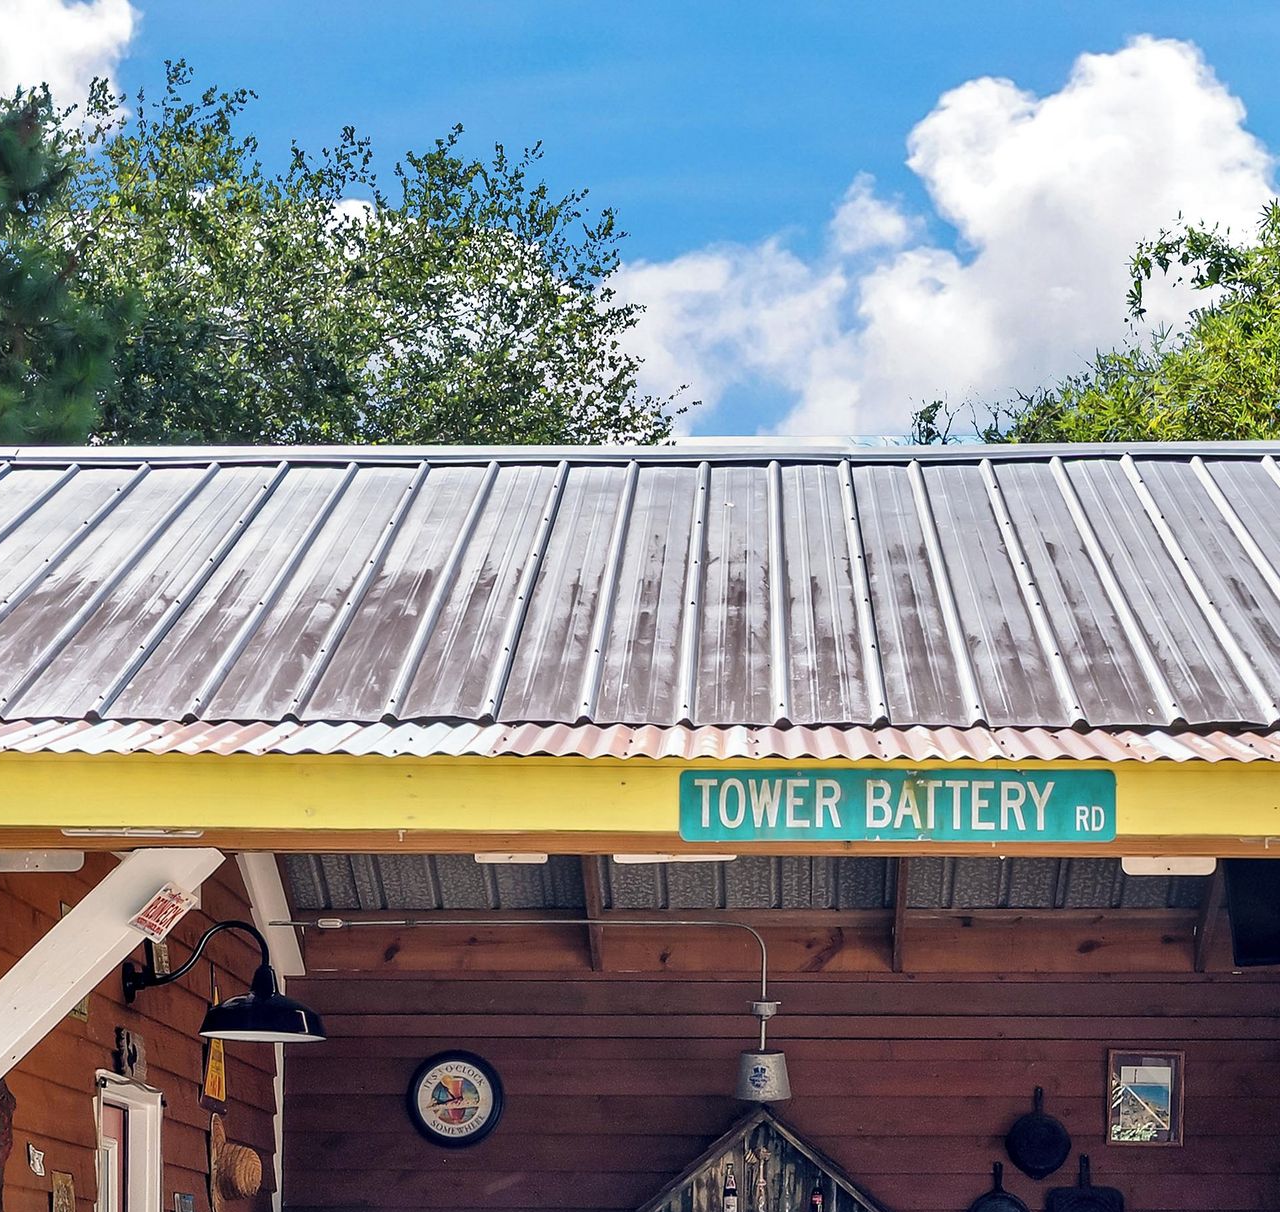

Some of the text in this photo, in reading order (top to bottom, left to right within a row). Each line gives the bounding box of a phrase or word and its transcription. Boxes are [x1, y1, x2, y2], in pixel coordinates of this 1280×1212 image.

[694, 778, 1106, 832] TOWER BATTERY RD
[445, 1063, 485, 1087] O'CLOCK
[431, 1115, 485, 1135] SOMEWHERE
